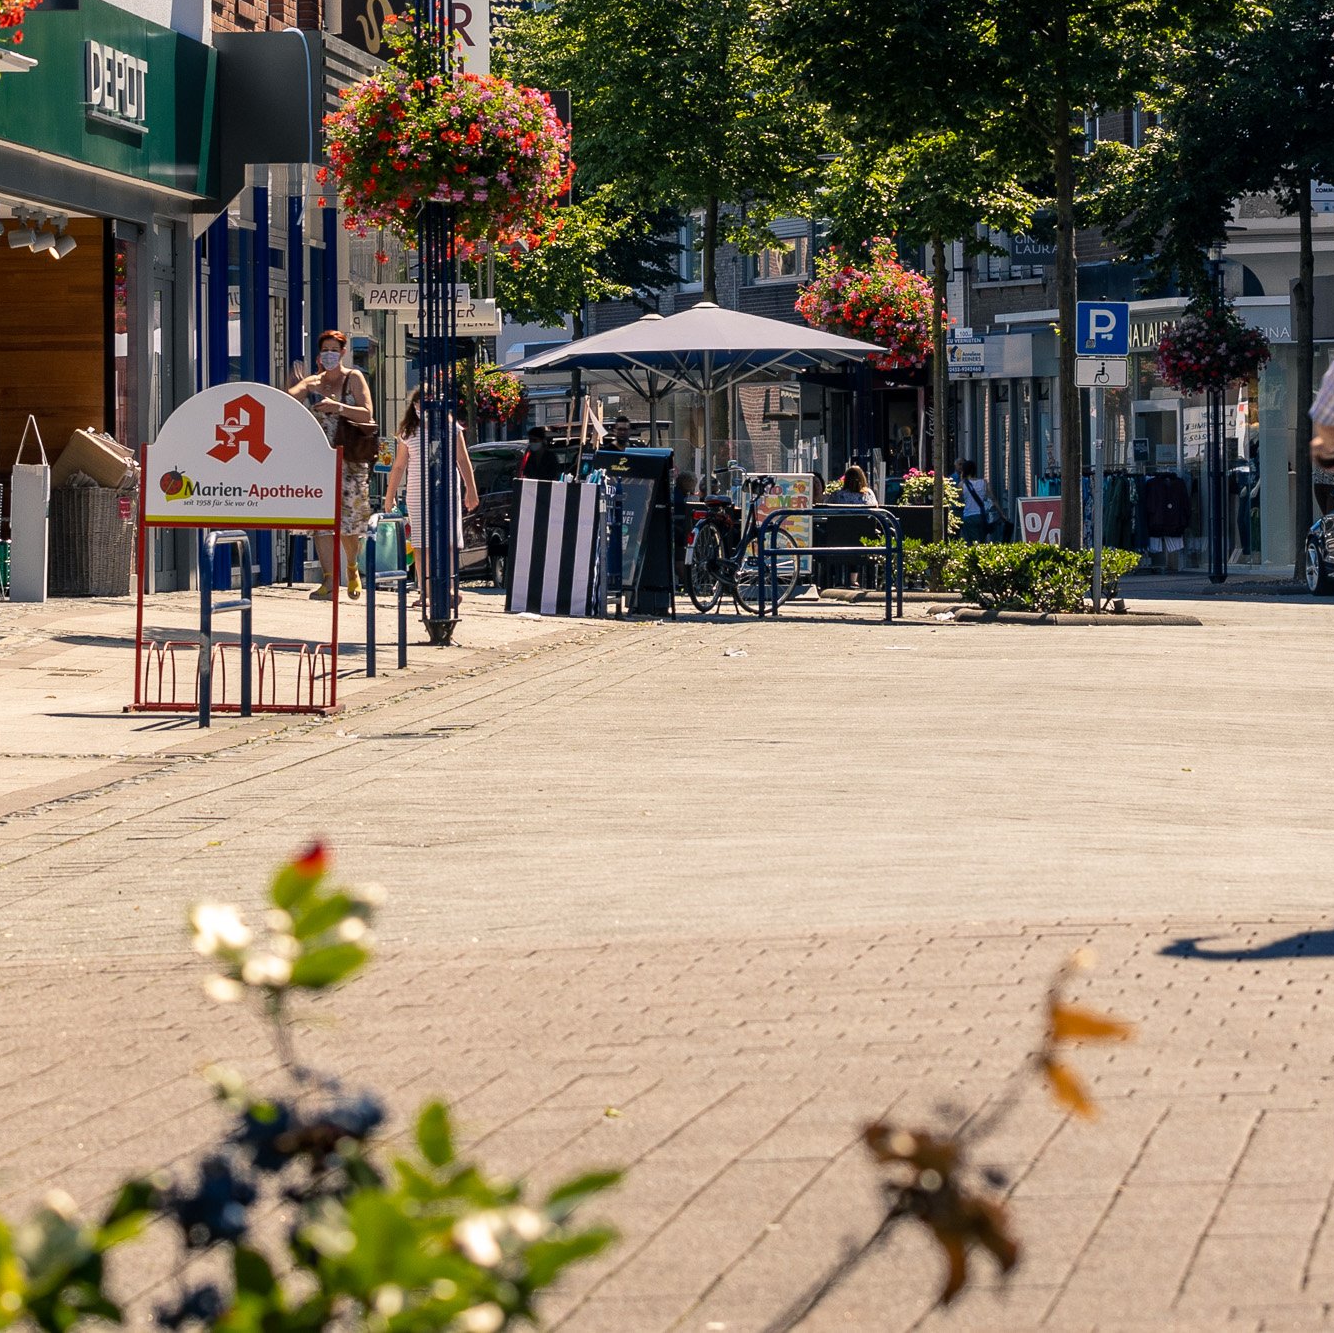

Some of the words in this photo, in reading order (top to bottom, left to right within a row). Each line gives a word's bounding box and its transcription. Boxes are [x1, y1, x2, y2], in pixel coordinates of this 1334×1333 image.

[86, 39, 148, 121] DEPOT
[1015, 245, 1058, 255] LAURA
[183, 481, 324, 500] Marien-Apotheke
[195, 499, 211, 507] 1958
[212, 499, 223, 508] für
[224, 499, 234, 507] Sie
